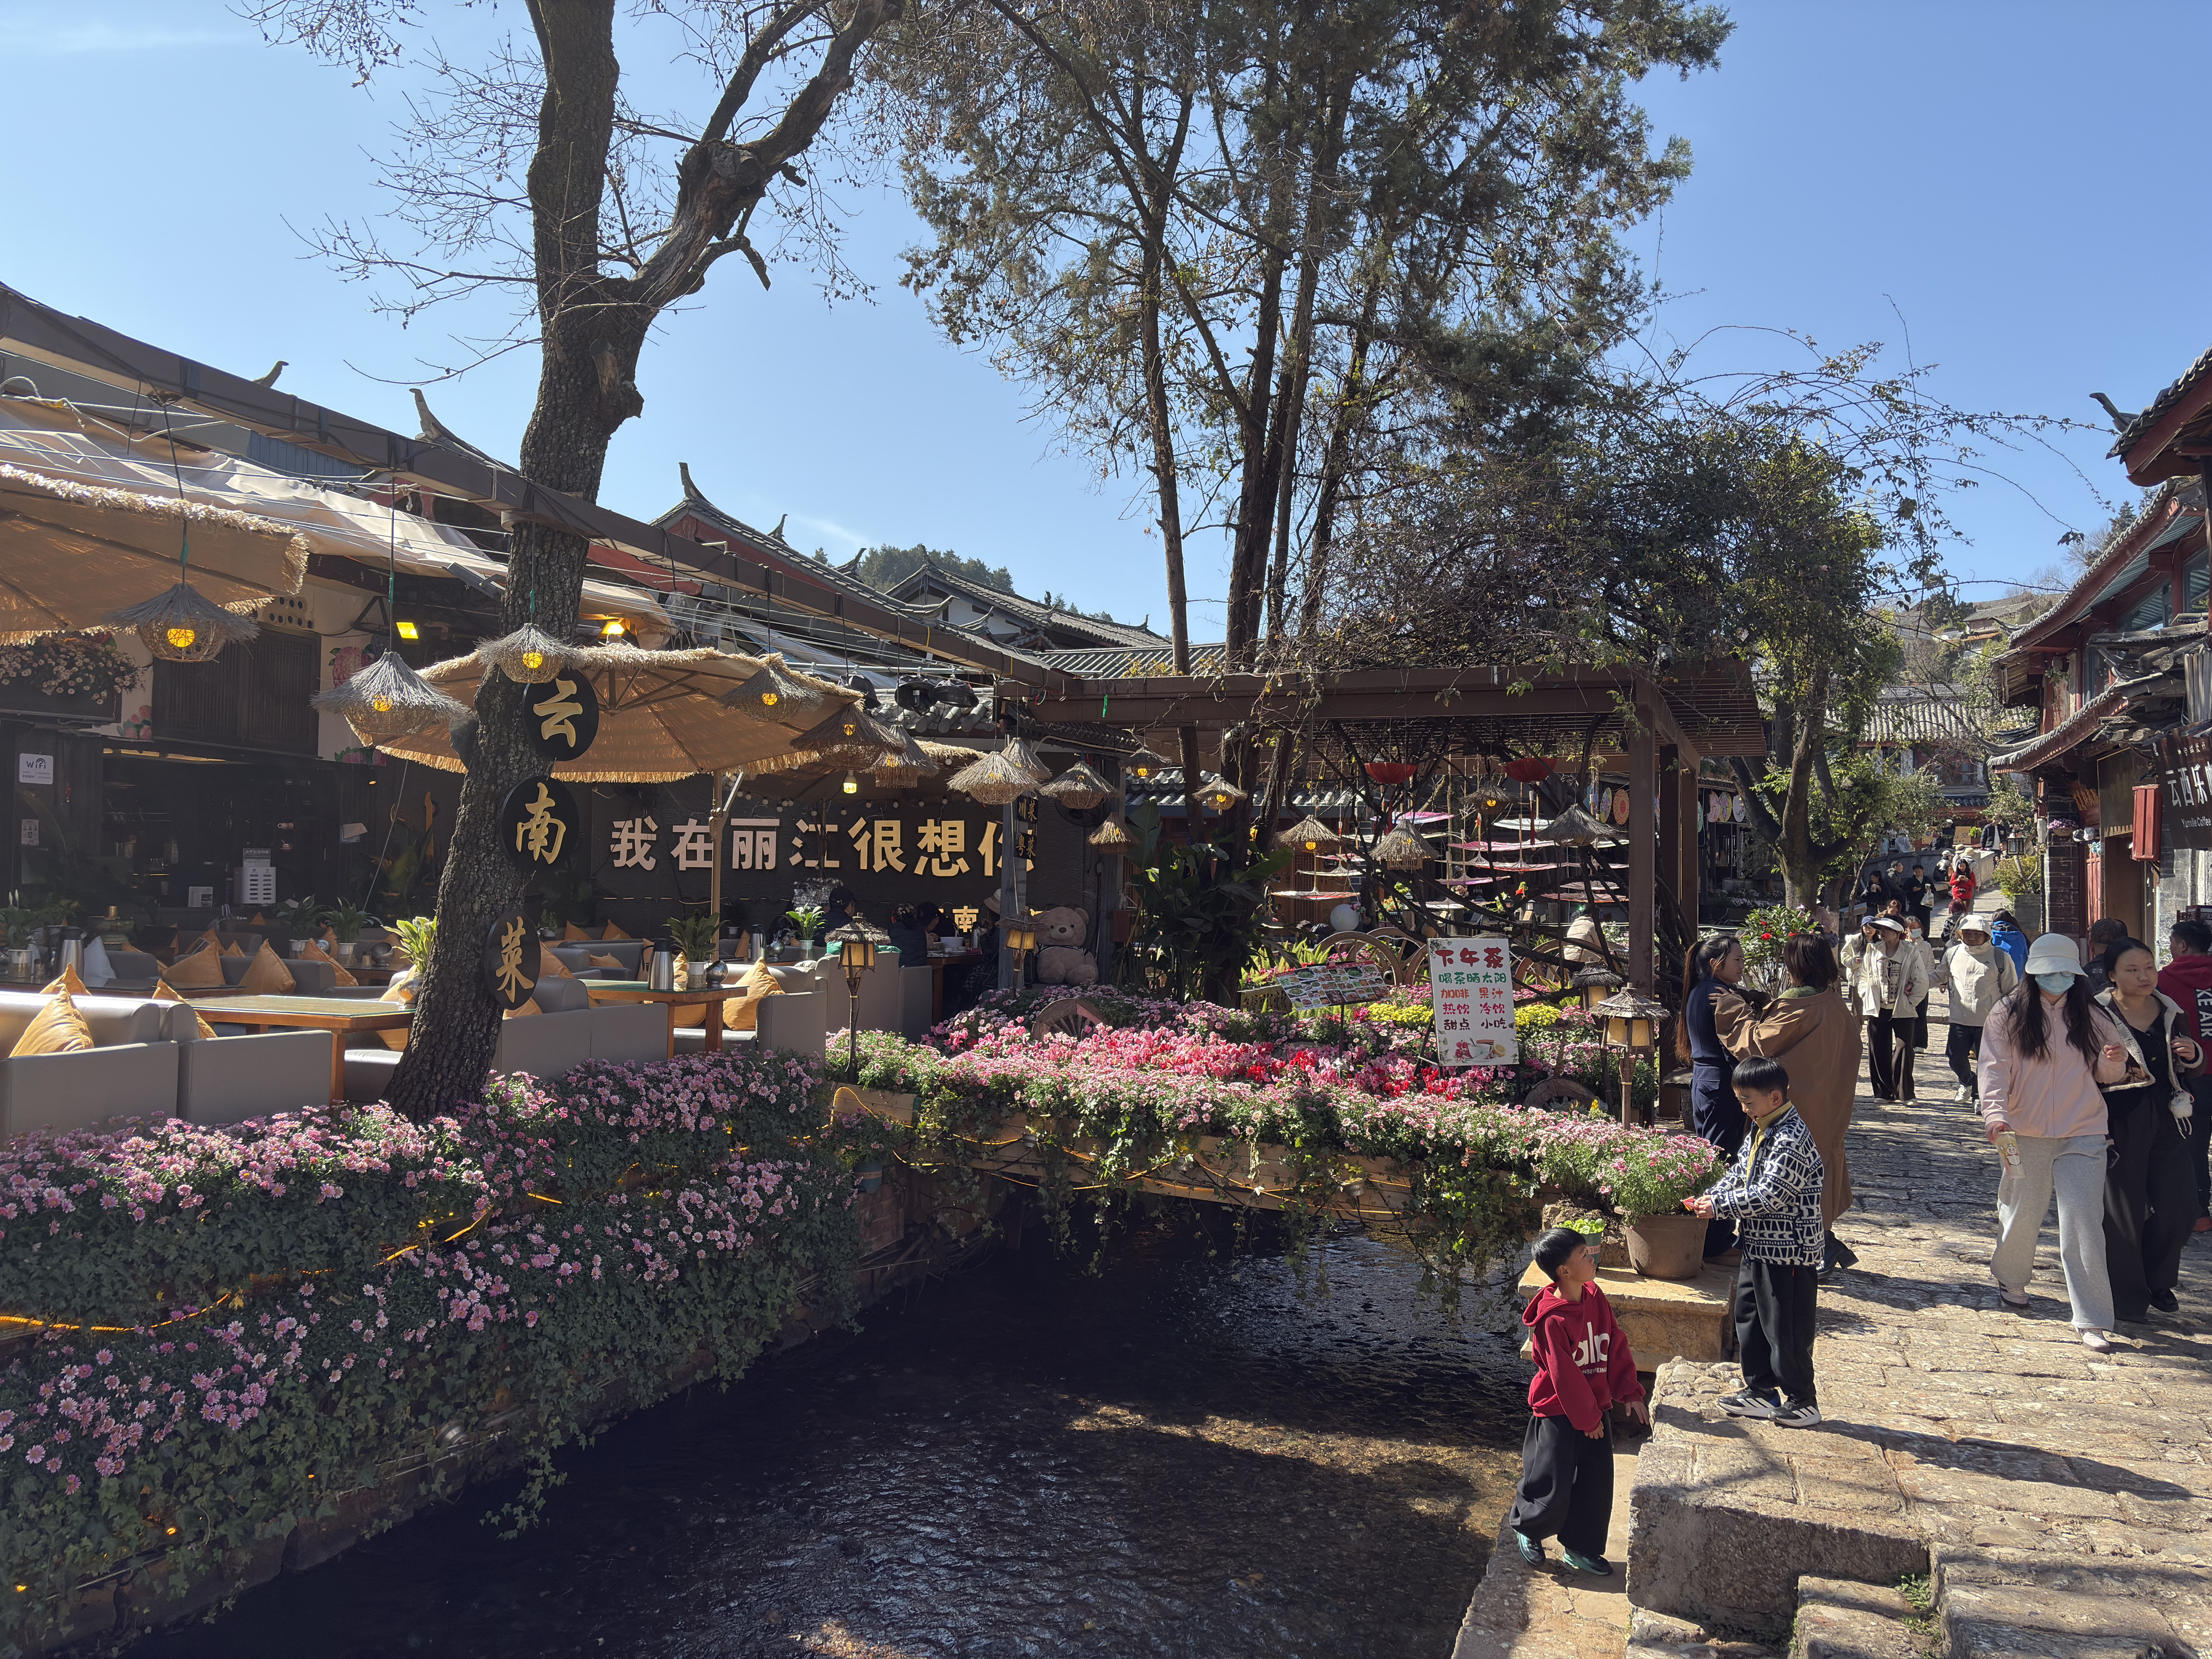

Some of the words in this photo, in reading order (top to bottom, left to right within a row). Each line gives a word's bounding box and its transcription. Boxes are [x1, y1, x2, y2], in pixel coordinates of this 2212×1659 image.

[1019, 798, 1037, 822] 川菜
[1435, 947, 1504, 969] 下午茶
[1438, 972, 1507, 985] 喝茶晒太阳
[1479, 987, 1504, 999] 果汁
[1442, 1002, 1470, 1015] 热饮
[1479, 1001, 1505, 1015] 冷饮
[1444, 1018, 1470, 1031] 甜点
[1481, 1017, 1507, 1030] 小吃
